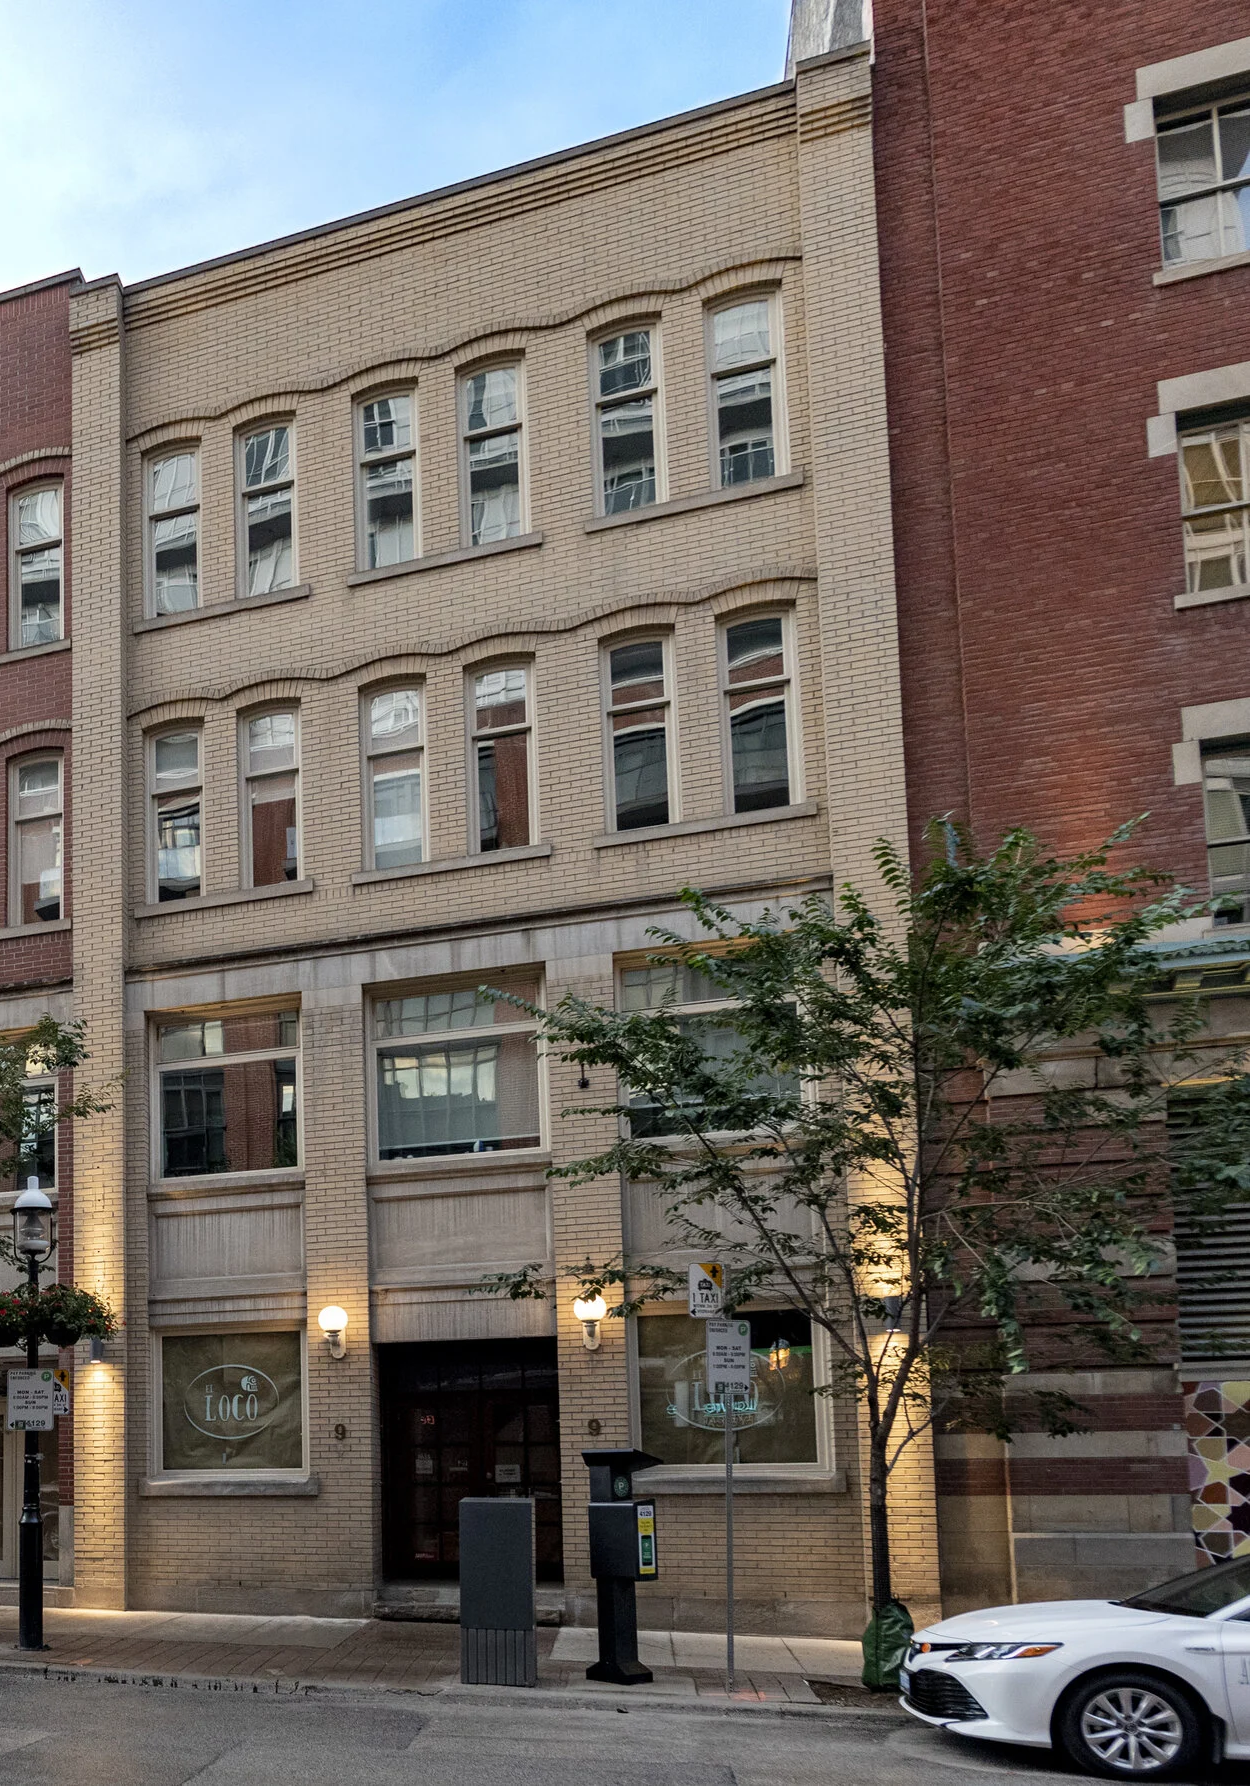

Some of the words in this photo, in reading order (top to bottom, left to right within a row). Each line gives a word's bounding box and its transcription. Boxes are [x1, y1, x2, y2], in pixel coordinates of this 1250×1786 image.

[700, 1293, 719, 1303] TAXI
[205, 1384, 213, 1393] EL
[54, 1394, 67, 1402] AXI
[205, 1394, 259, 1422] LOCO
[333, 1423, 347, 1441] 9
[587, 1419, 601, 1436] 9
